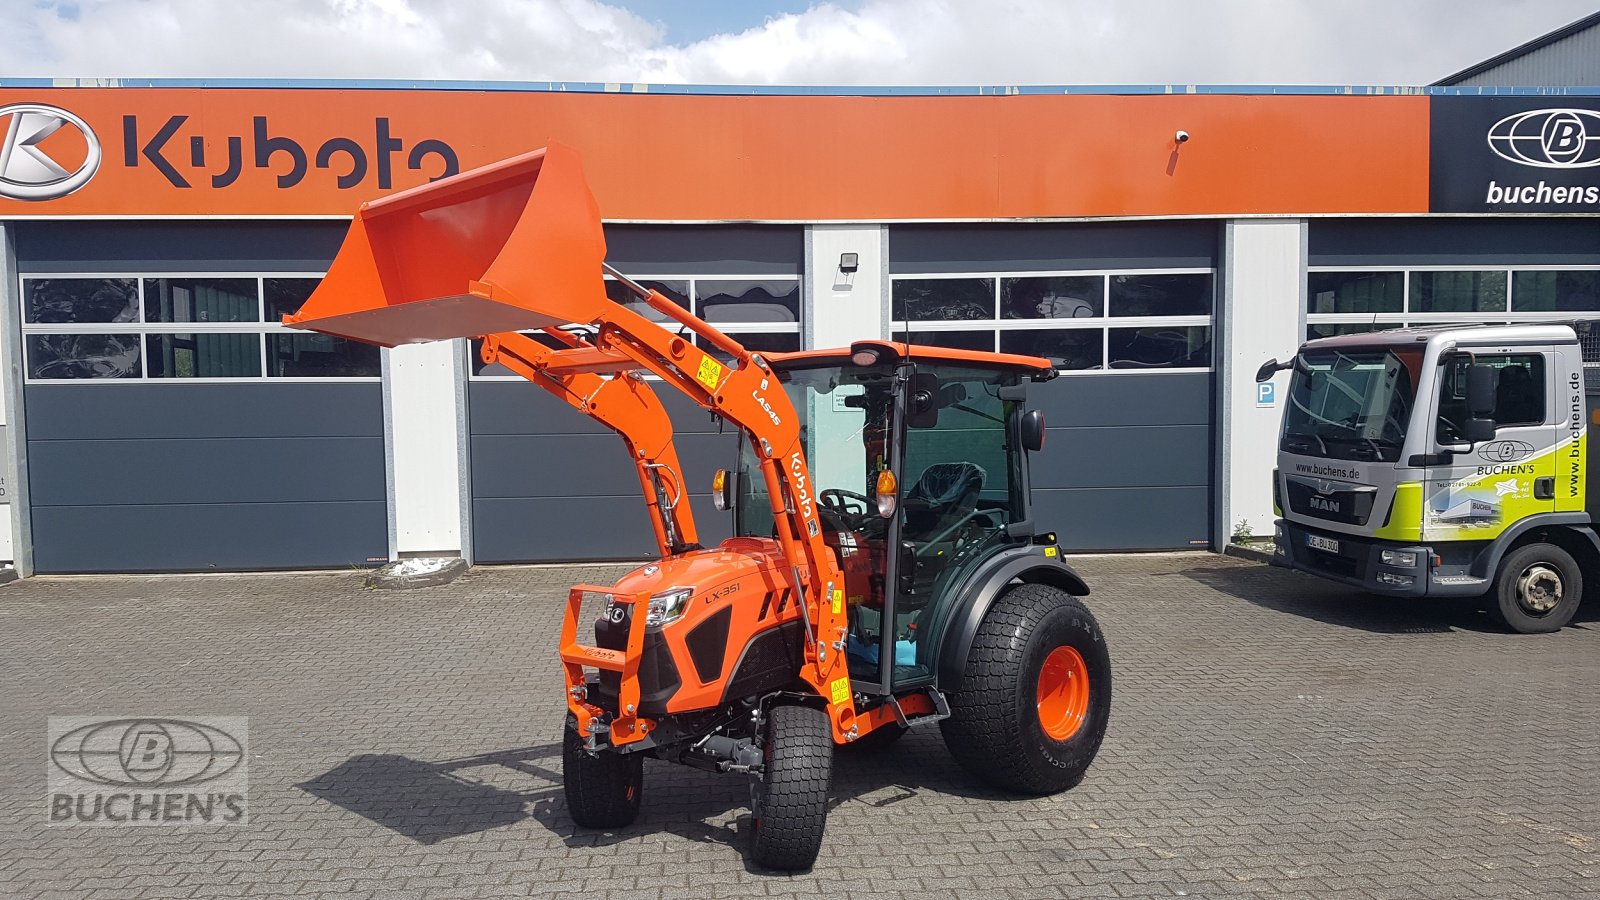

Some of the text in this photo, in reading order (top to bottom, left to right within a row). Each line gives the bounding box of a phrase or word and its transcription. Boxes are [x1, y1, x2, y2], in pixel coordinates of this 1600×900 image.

[122, 114, 460, 190] Kubota
[1259, 384, 1273, 402] P
[752, 389, 782, 426] LA545
[1568, 371, 1581, 498] www.buchens.de
[1295, 463, 1361, 480] www.buchens.de
[1476, 464, 1535, 476] BUCHEN'S
[791, 451, 812, 519] Kubota
[1309, 497, 1340, 513] MAN
[705, 582, 741, 605] LX-351
